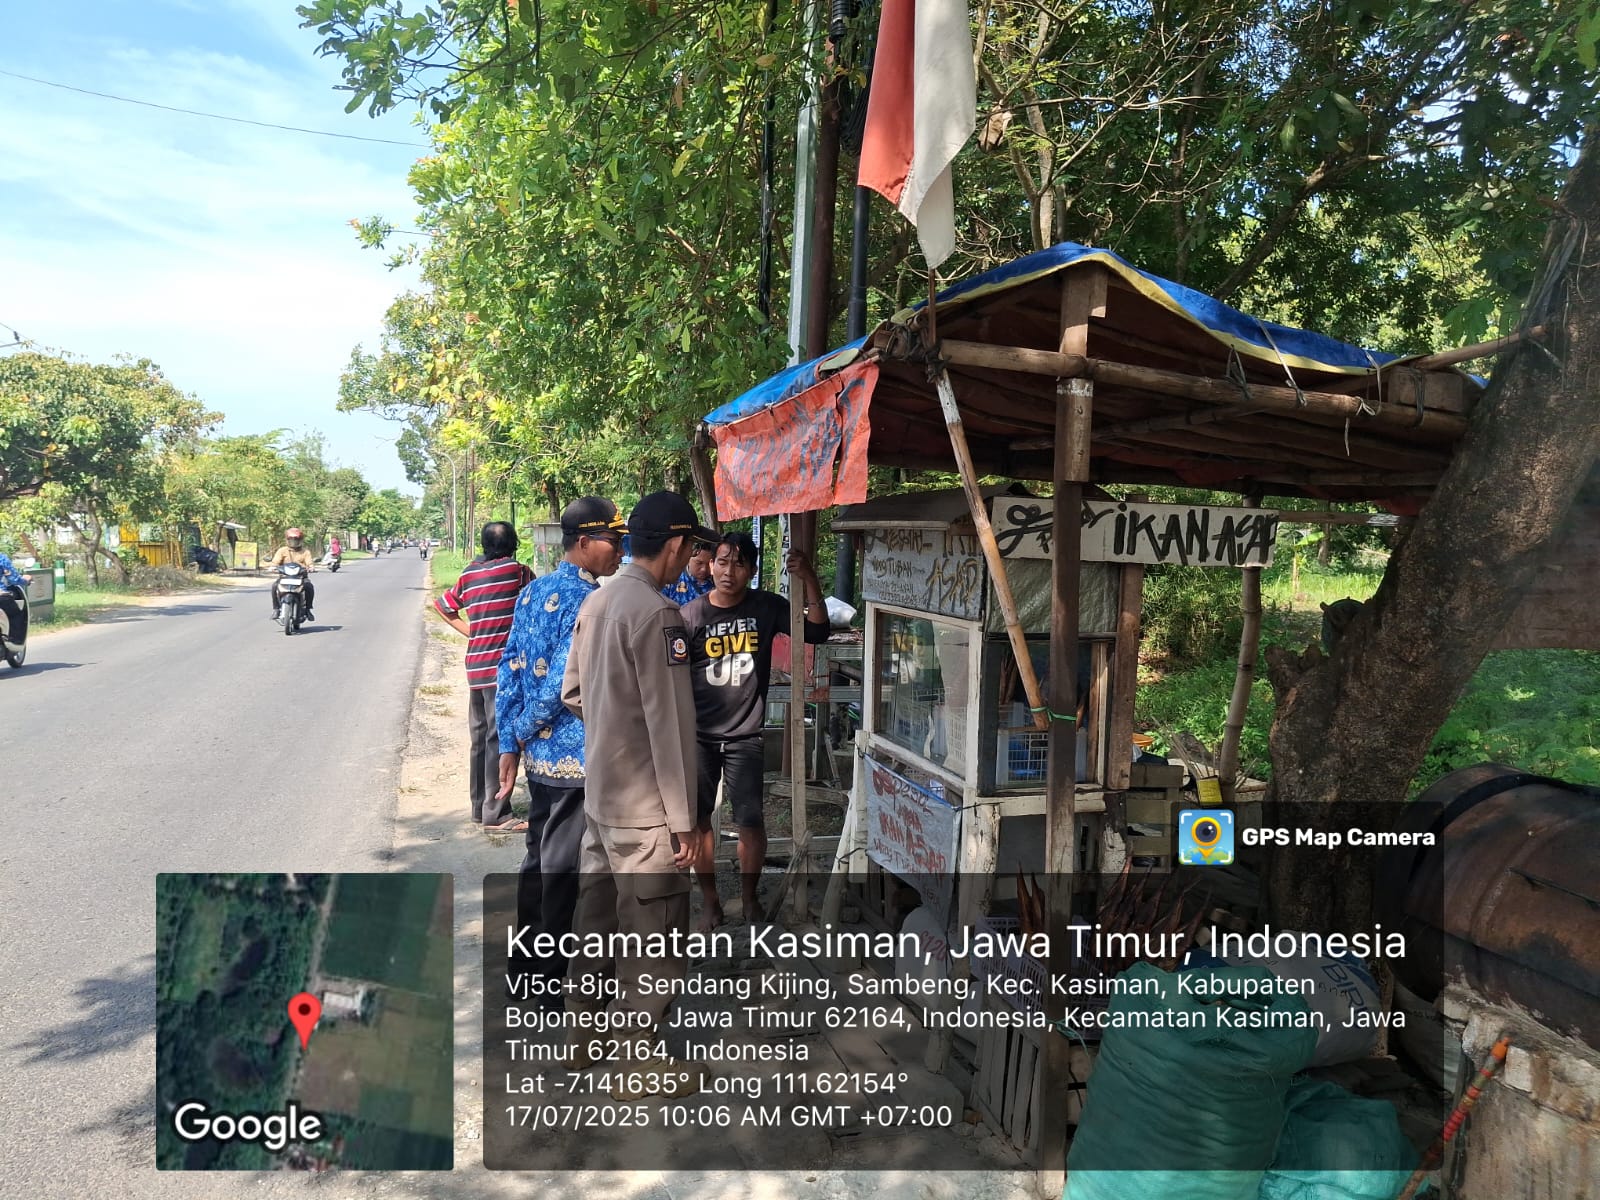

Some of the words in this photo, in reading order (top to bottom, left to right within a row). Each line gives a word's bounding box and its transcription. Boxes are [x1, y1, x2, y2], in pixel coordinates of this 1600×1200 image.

[705, 617, 758, 639] NEVER
[705, 631, 759, 658] GIVE
[705, 653, 755, 687] UP
